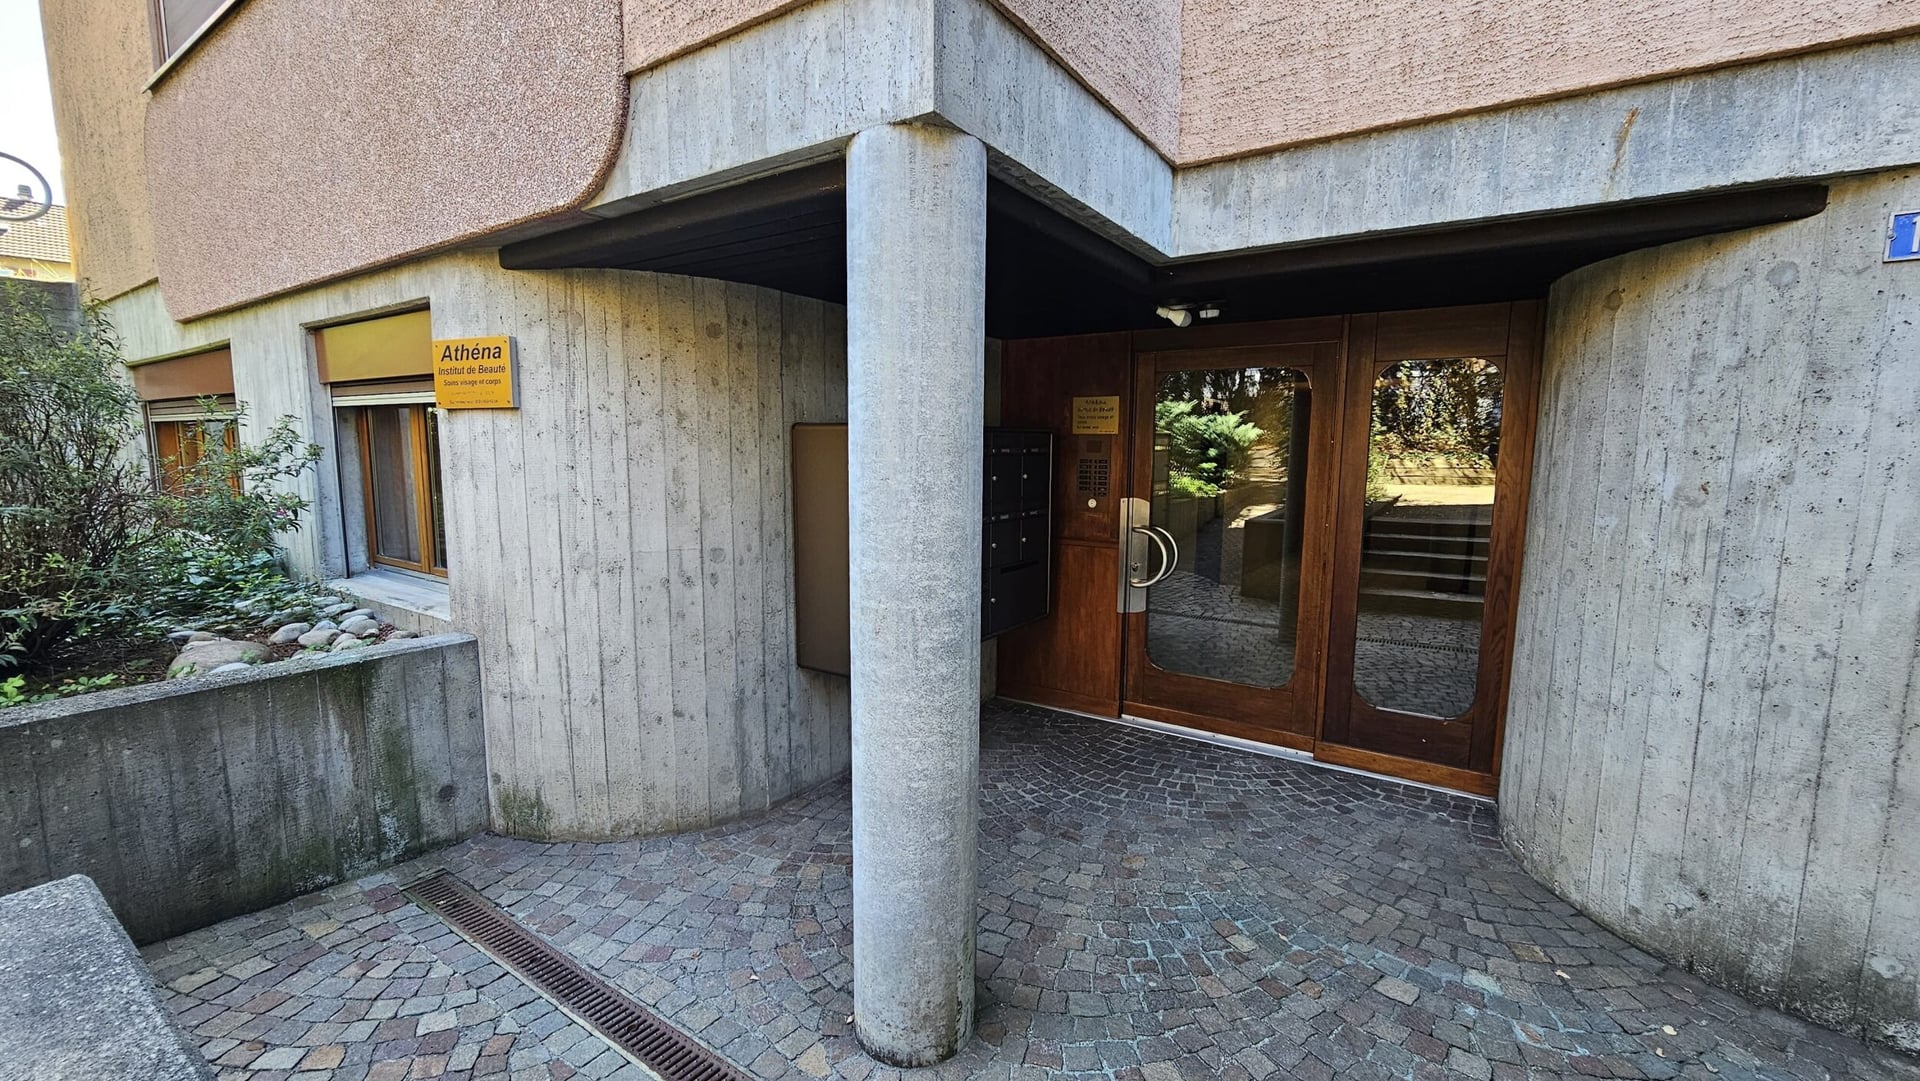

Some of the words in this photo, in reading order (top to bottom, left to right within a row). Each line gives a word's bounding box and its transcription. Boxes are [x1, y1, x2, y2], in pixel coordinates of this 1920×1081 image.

[440, 342, 502, 362] Athéna
[438, 365, 465, 376] Institut
[466, 365, 477, 375] de
[478, 363, 506, 374] Beauté
[443, 379, 459, 387] Soins
[460, 379, 478, 387] visage
[485, 378, 502, 386] corps
